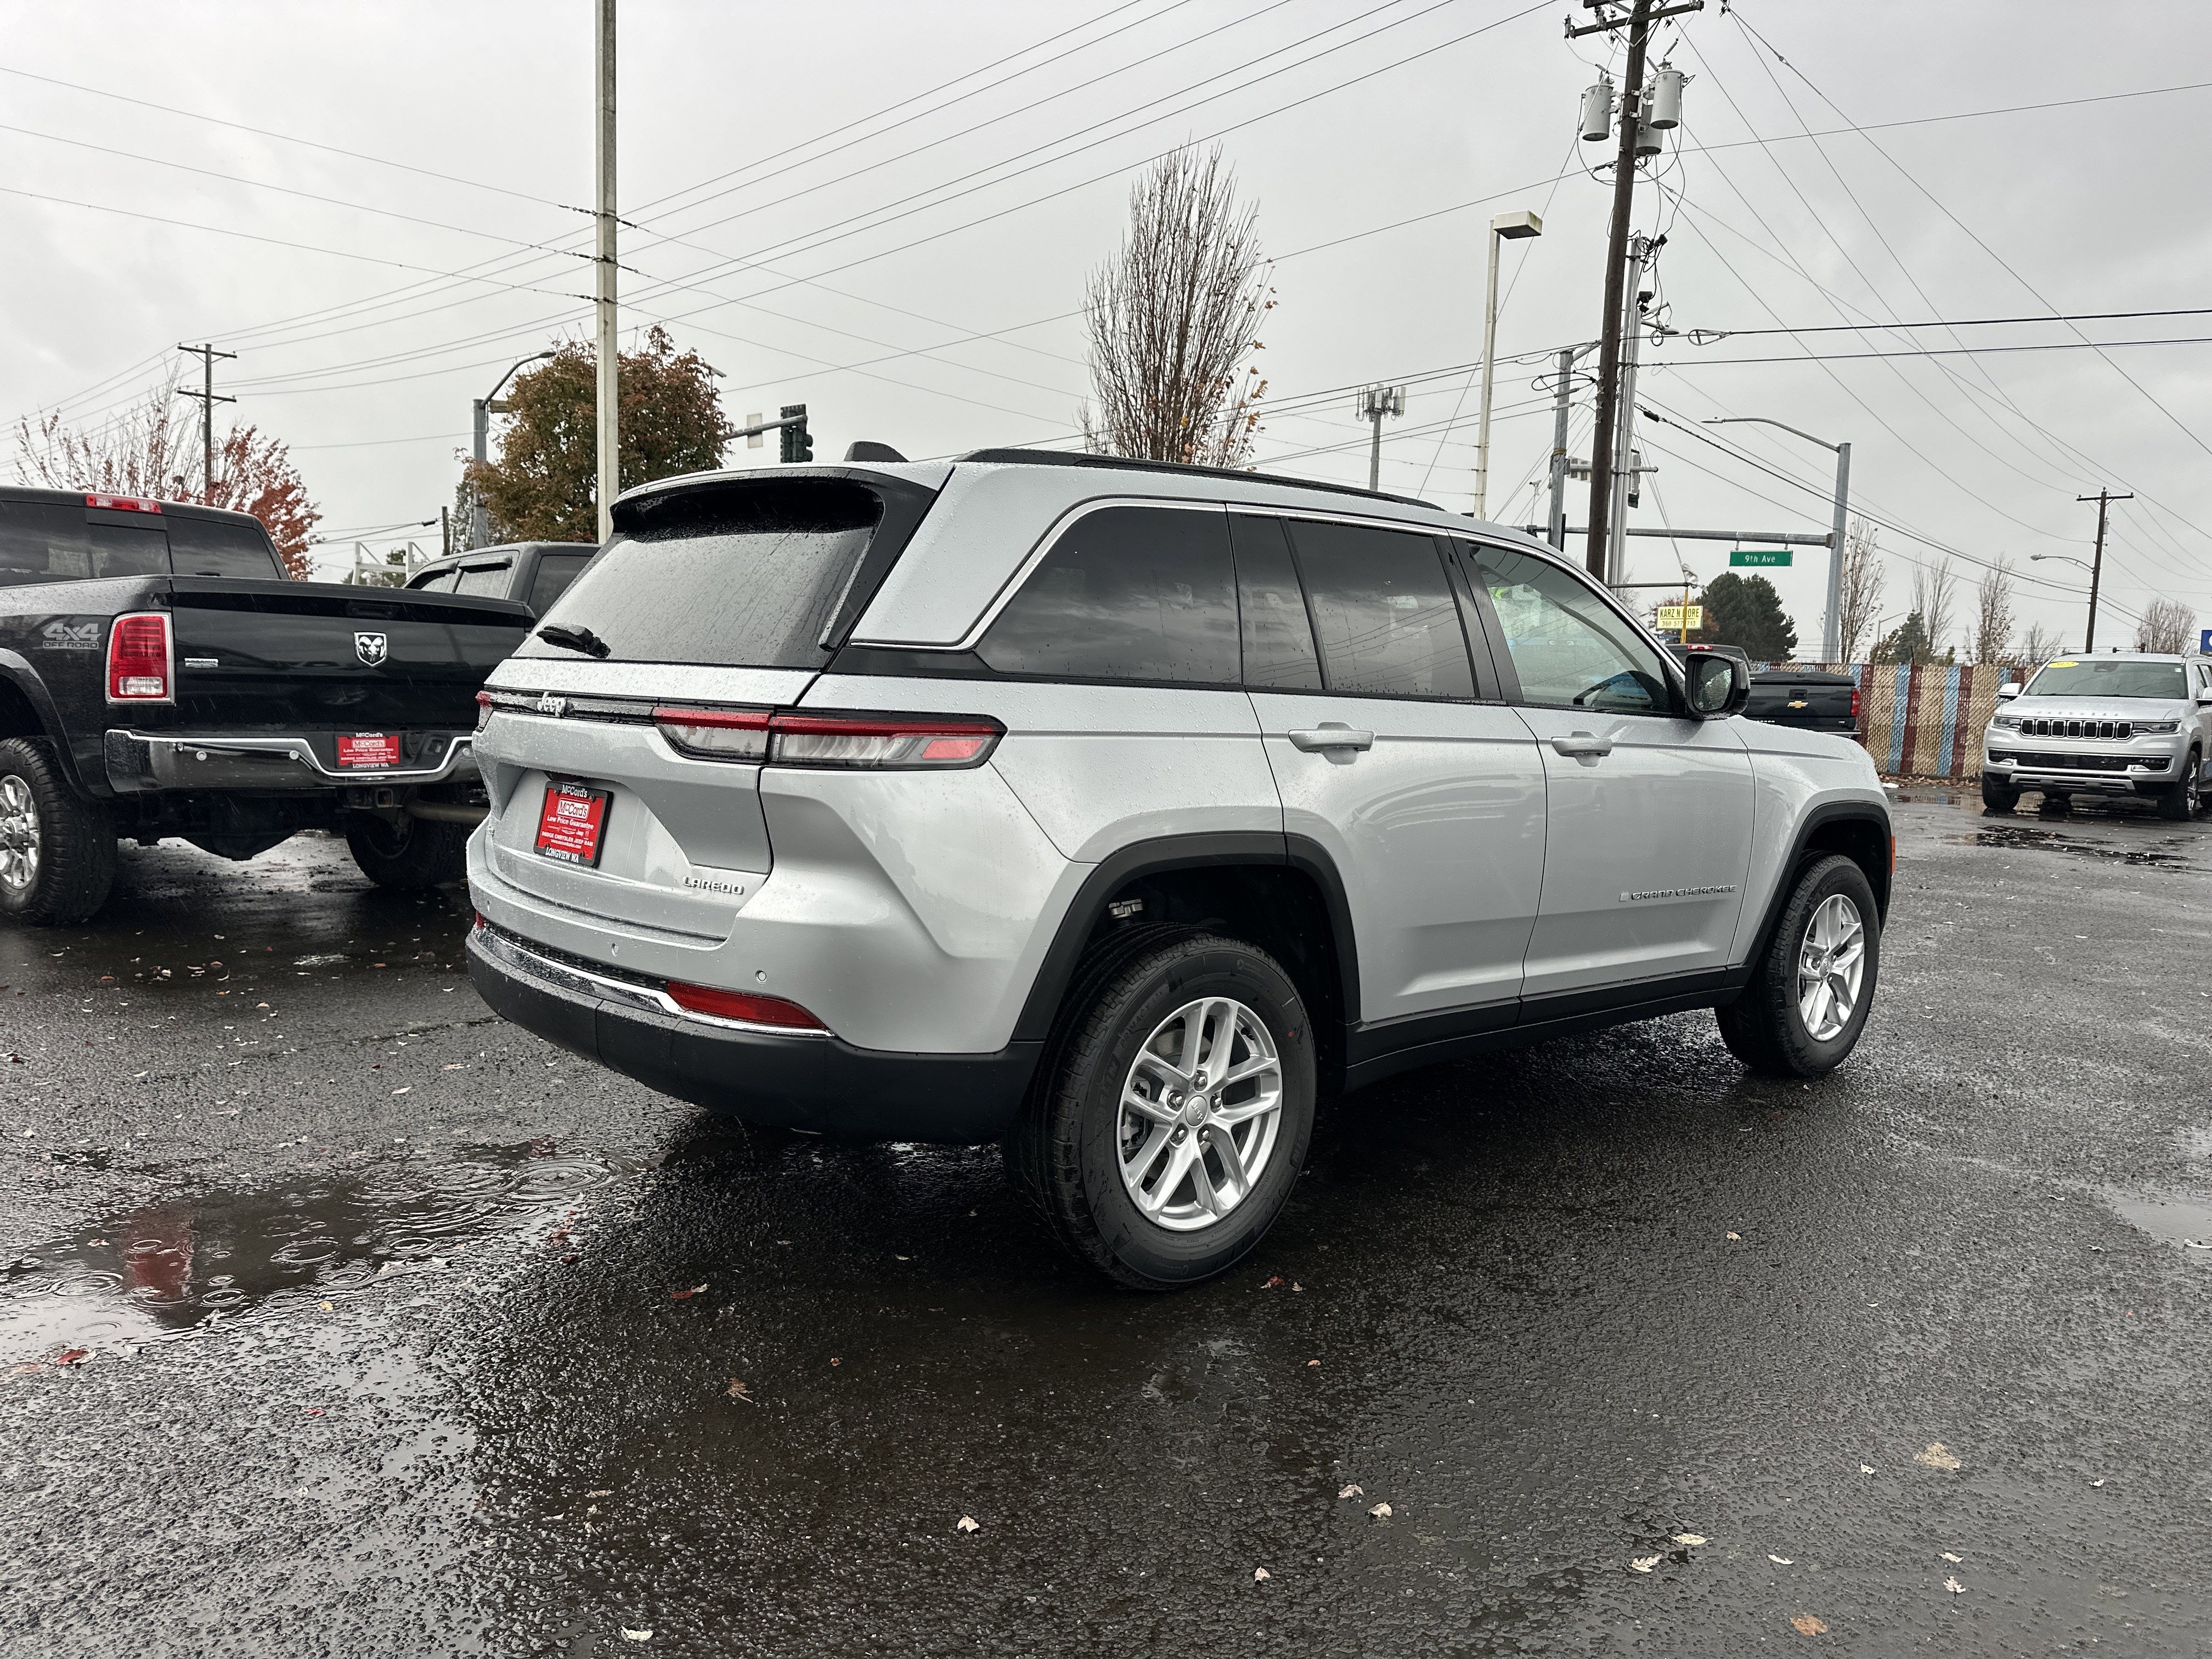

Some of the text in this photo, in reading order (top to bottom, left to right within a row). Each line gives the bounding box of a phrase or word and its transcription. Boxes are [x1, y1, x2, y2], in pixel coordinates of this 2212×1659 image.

[1745, 555, 1776, 563] 9th Ave
[1660, 608, 1699, 618] KARZ N ORE
[537, 691, 566, 719] Jeep
[561, 784, 588, 798] McCord's
[558, 801, 588, 817] McCord's
[546, 814, 557, 822] Low
[556, 816, 569, 825] Price
[569, 819, 594, 830] Guarantee
[545, 847, 579, 864] LONGVIEW WA
[682, 876, 744, 895] LAREDO
[1631, 885, 1738, 900] GRAND CHEROKEE
